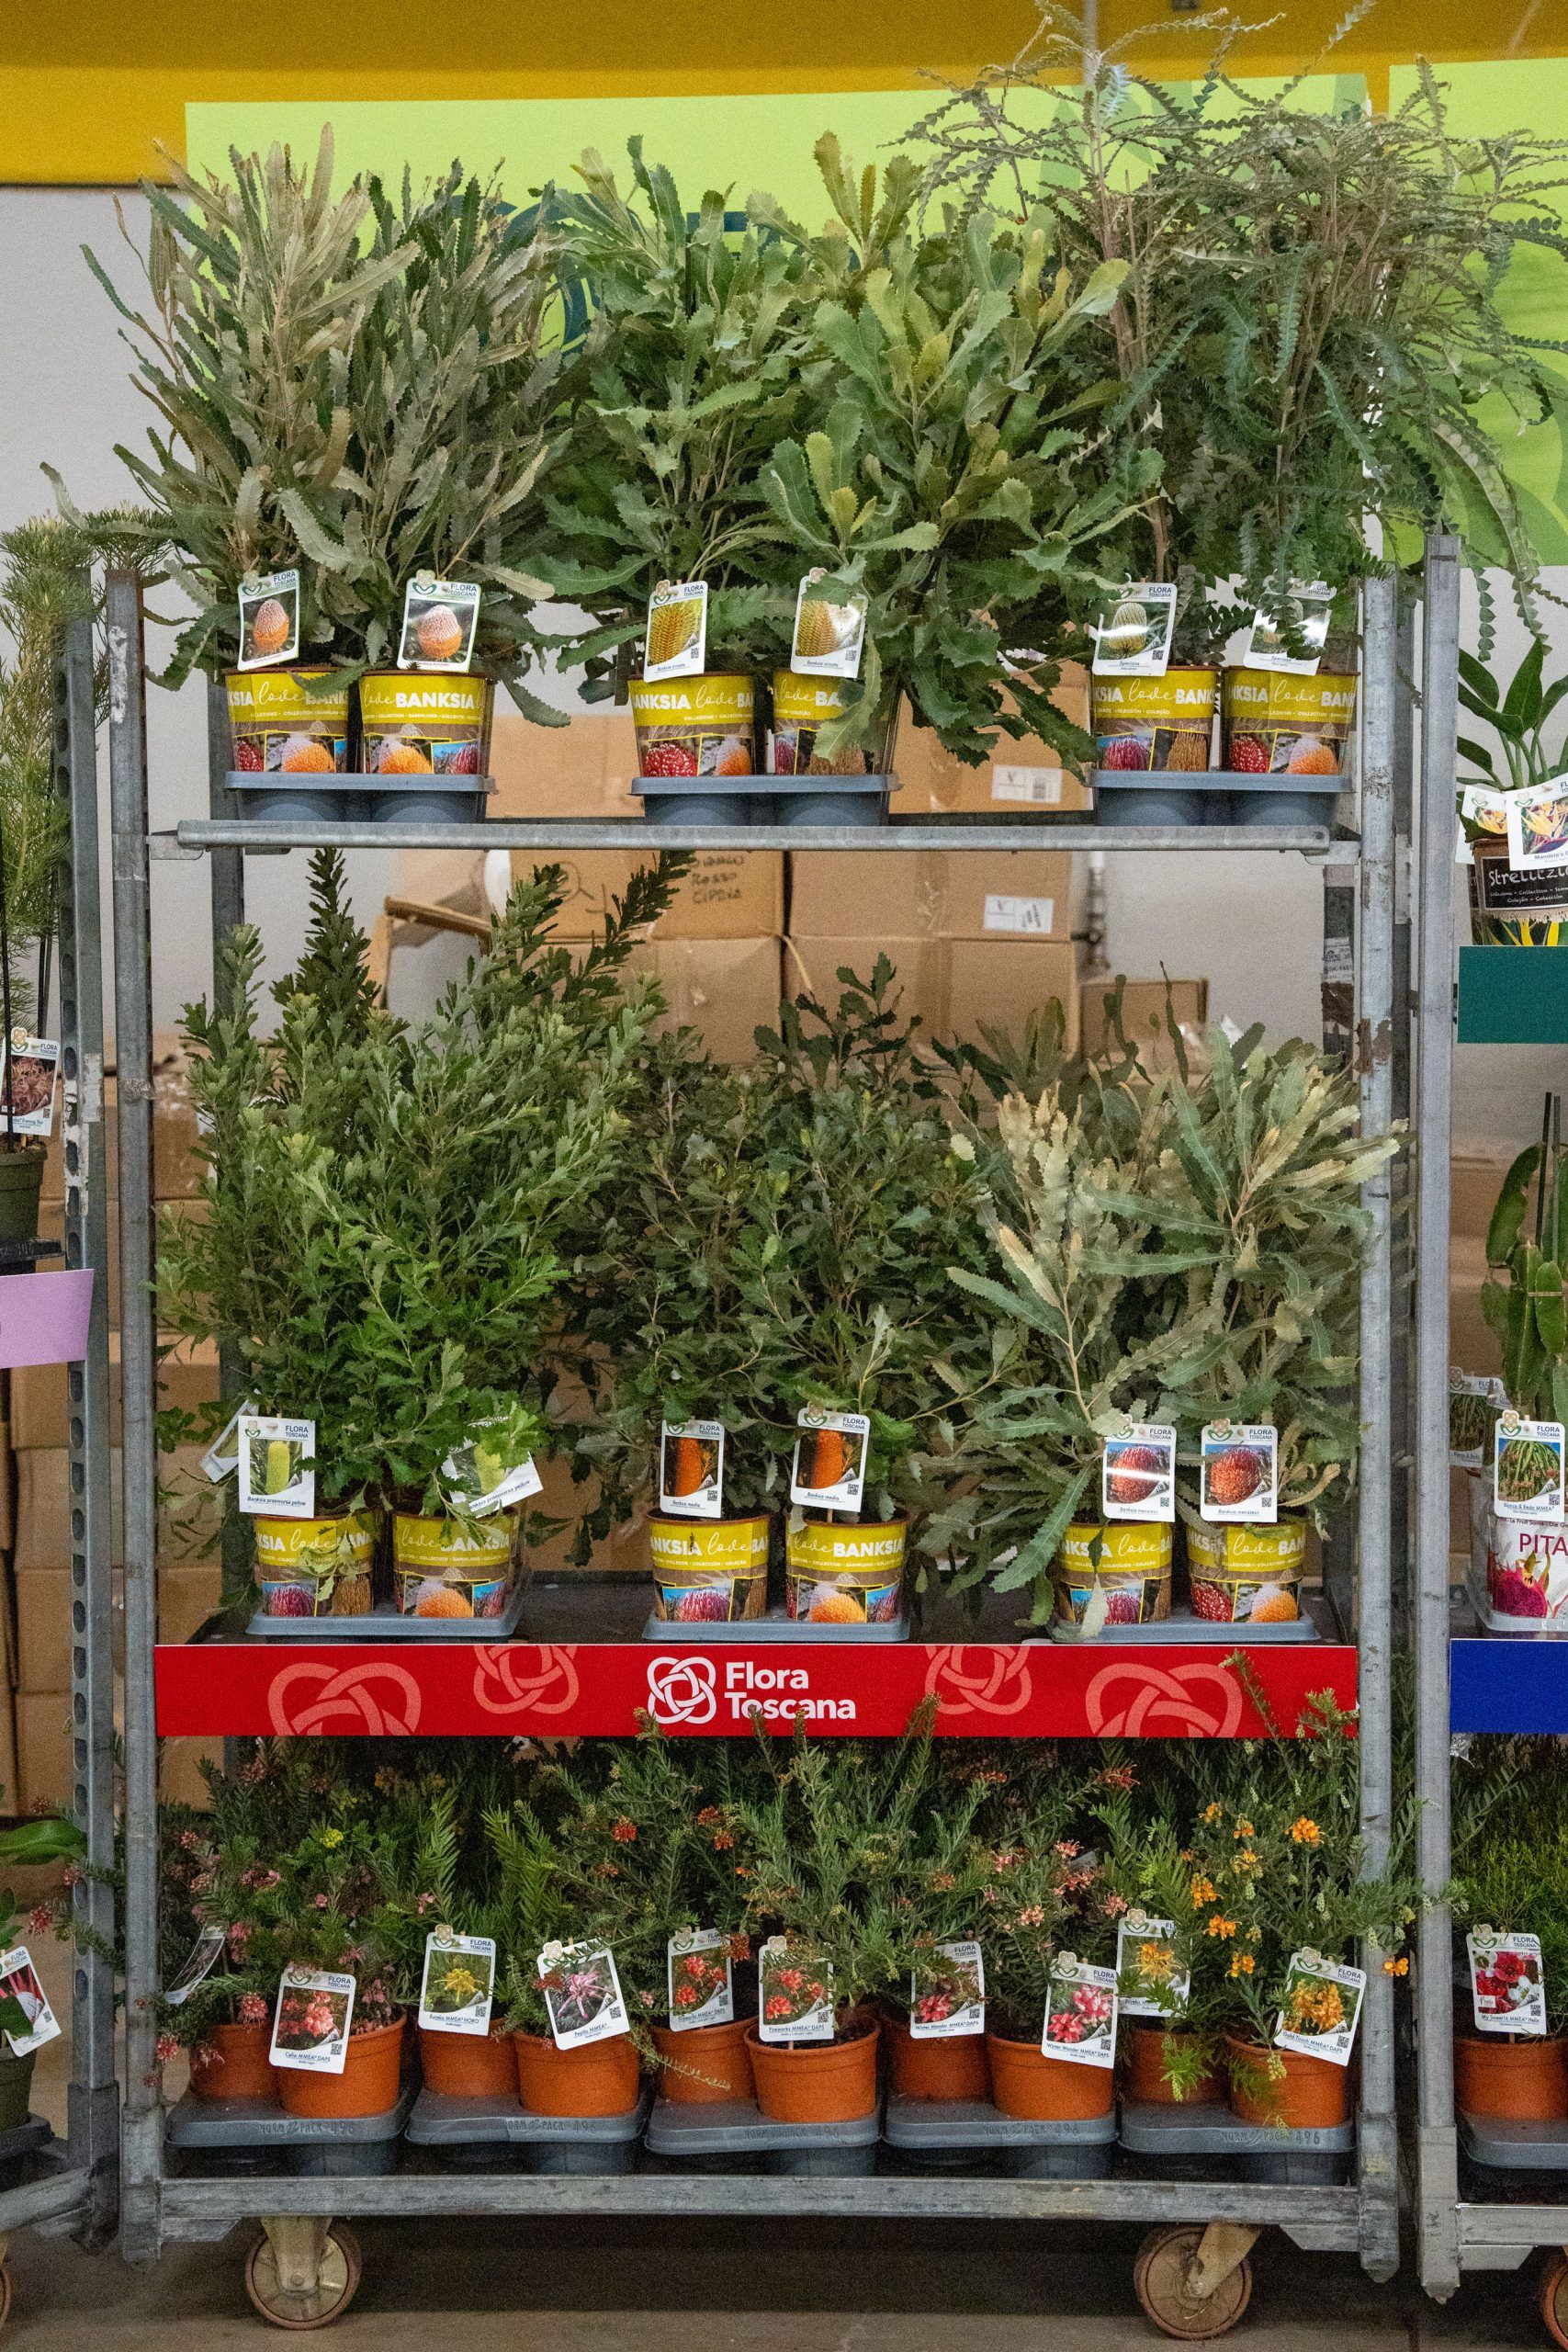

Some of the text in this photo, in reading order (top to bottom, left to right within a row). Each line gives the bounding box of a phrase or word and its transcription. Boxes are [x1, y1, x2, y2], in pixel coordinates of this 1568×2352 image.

[274, 571, 296, 582] FLORA
[274, 578, 296, 587] TOSCANA
[450, 583, 477, 592] FLORA
[683, 584, 704, 593] FLORA
[259, 682, 305, 706] love
[696, 685, 738, 708] love
[1128, 678, 1176, 702] love
[1274, 680, 1321, 704] love
[395, 692, 474, 709] BANKSIA
[842, 1417, 865, 1425] FLORA
[290, 1529, 337, 1552] love
[707, 1532, 751, 1555] love
[833, 1538, 904, 1557] BANKSIA
[1119, 1533, 1160, 1556] love
[1233, 1533, 1279, 1555] love
[1519, 1532, 1568, 1556] PITA
[726, 1661, 808, 1690] Flora
[725, 1692, 856, 1719] Toscana
[10, 1950, 26, 1961] FLORA
[954, 1944, 976, 1952] FLORA
[328, 1976, 351, 1984] FLORA
[1093, 1970, 1115, 1979] FLORA
[1338, 1968, 1361, 1979] FLORA
